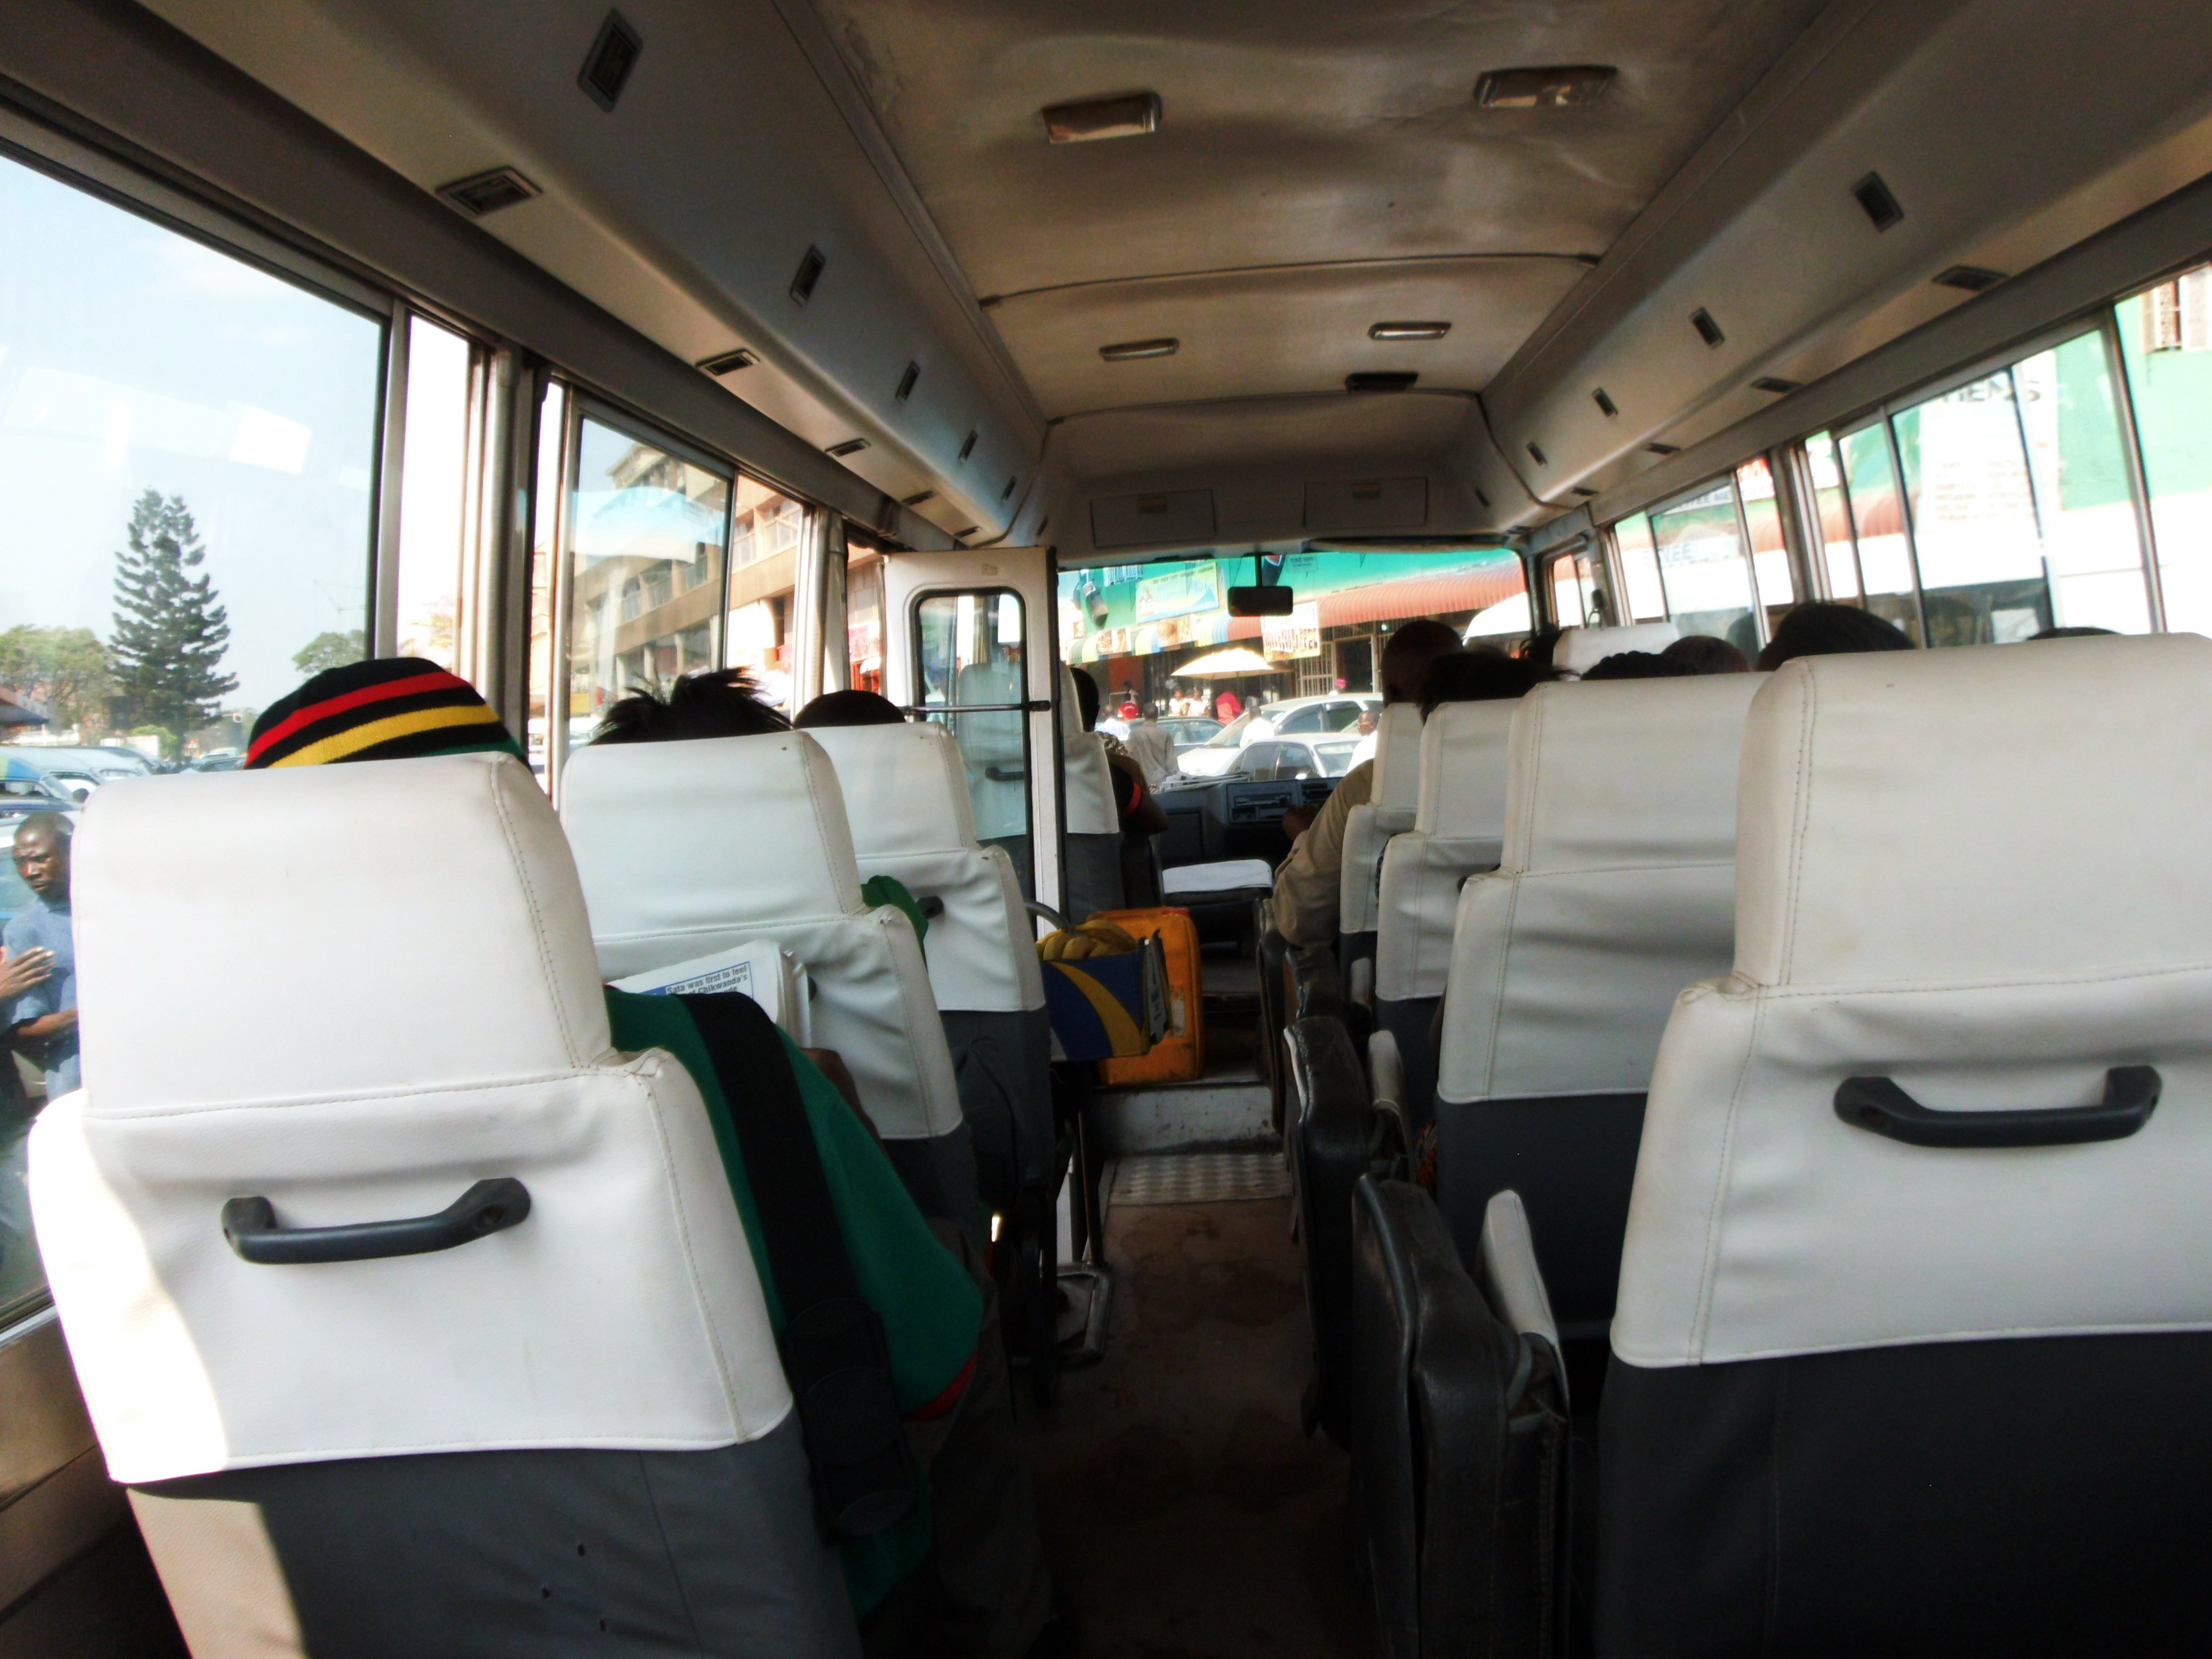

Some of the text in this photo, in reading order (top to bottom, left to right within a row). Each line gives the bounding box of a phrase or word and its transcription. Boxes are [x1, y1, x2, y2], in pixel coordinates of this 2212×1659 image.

[687, 980, 704, 989] was
[705, 974, 720, 983] first
[732, 965, 747, 975] feel
